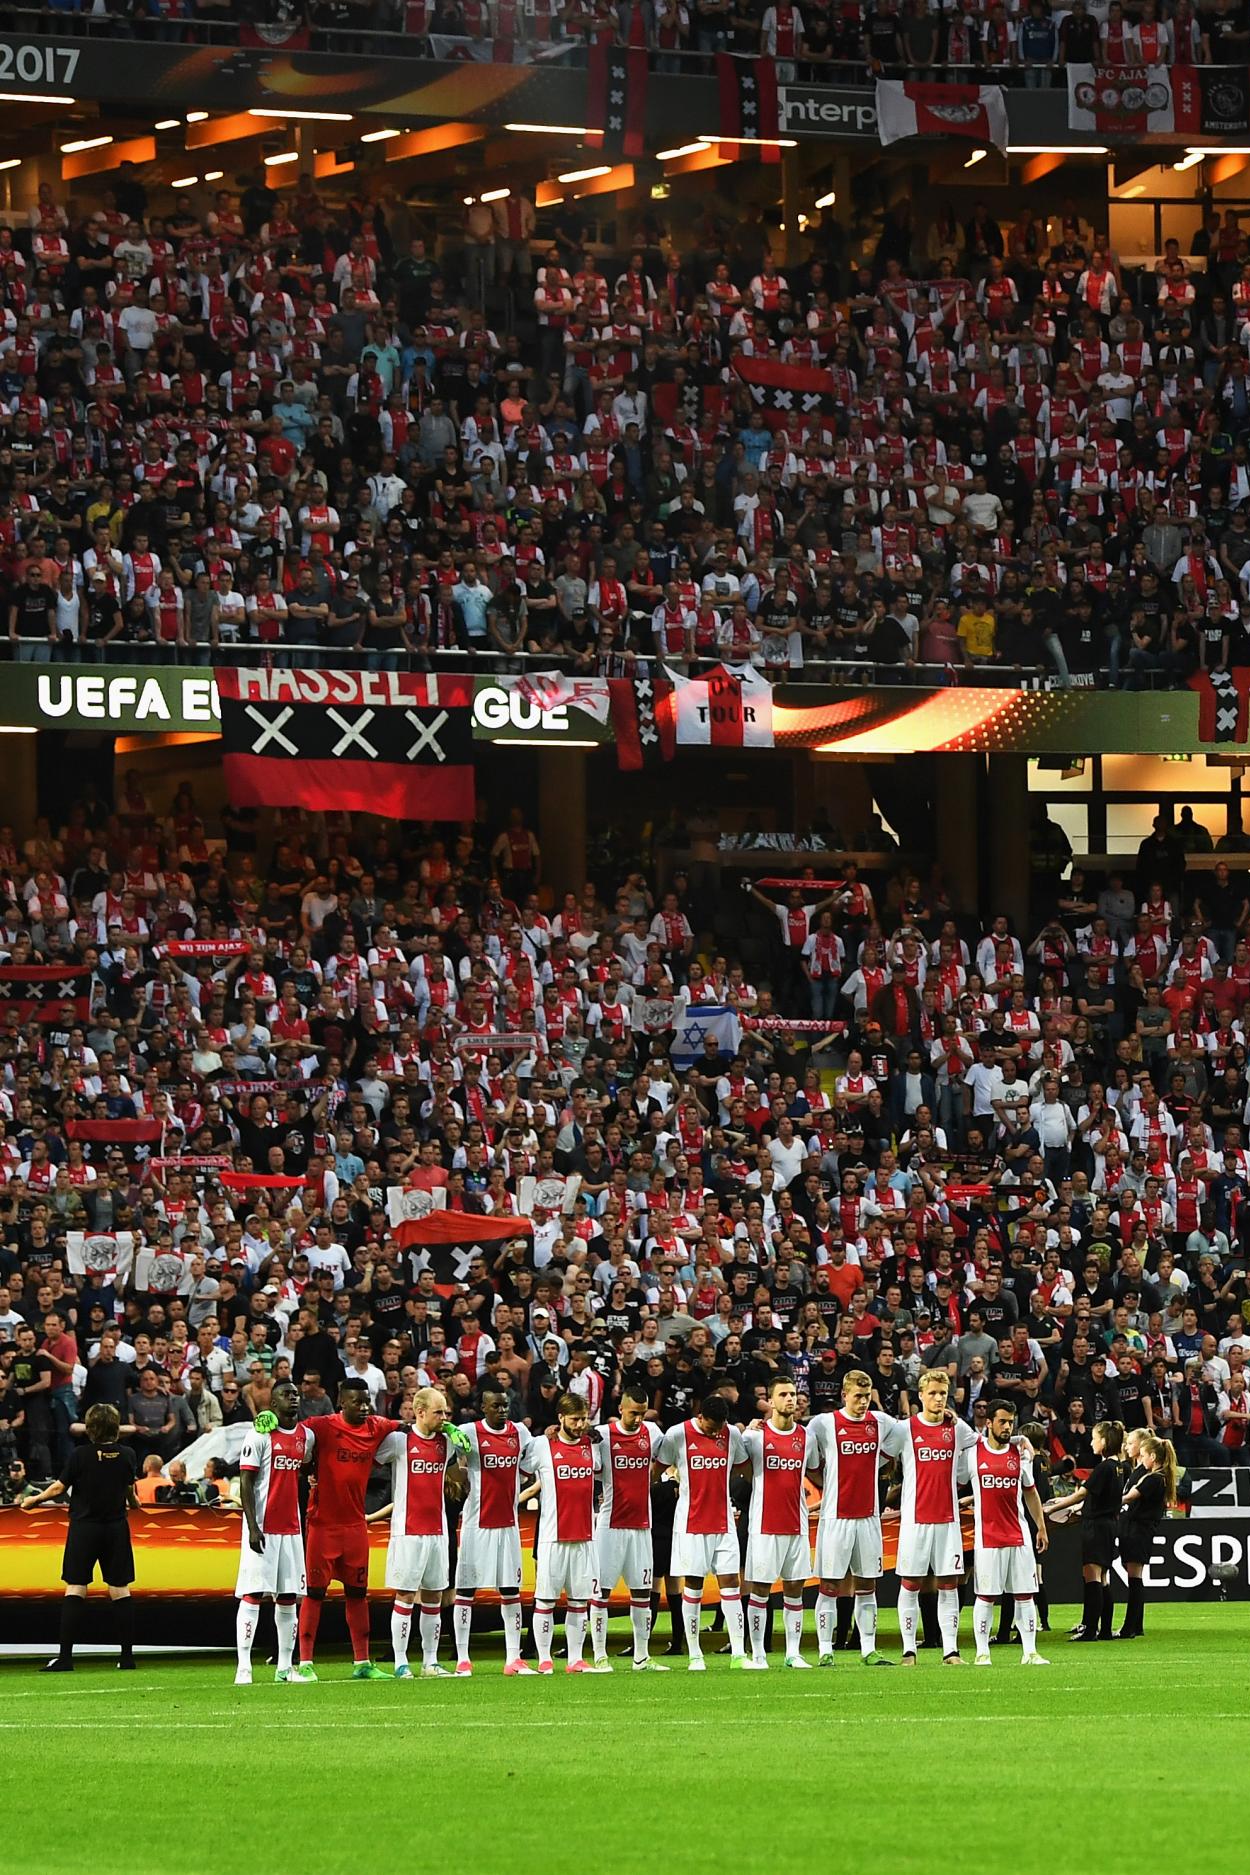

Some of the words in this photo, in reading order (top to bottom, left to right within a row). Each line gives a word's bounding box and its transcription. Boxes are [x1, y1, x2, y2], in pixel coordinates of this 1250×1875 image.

[0, 43, 80, 84] 2017
[37, 674, 171, 720] UEFA
[695, 706, 756, 723] TOUR
